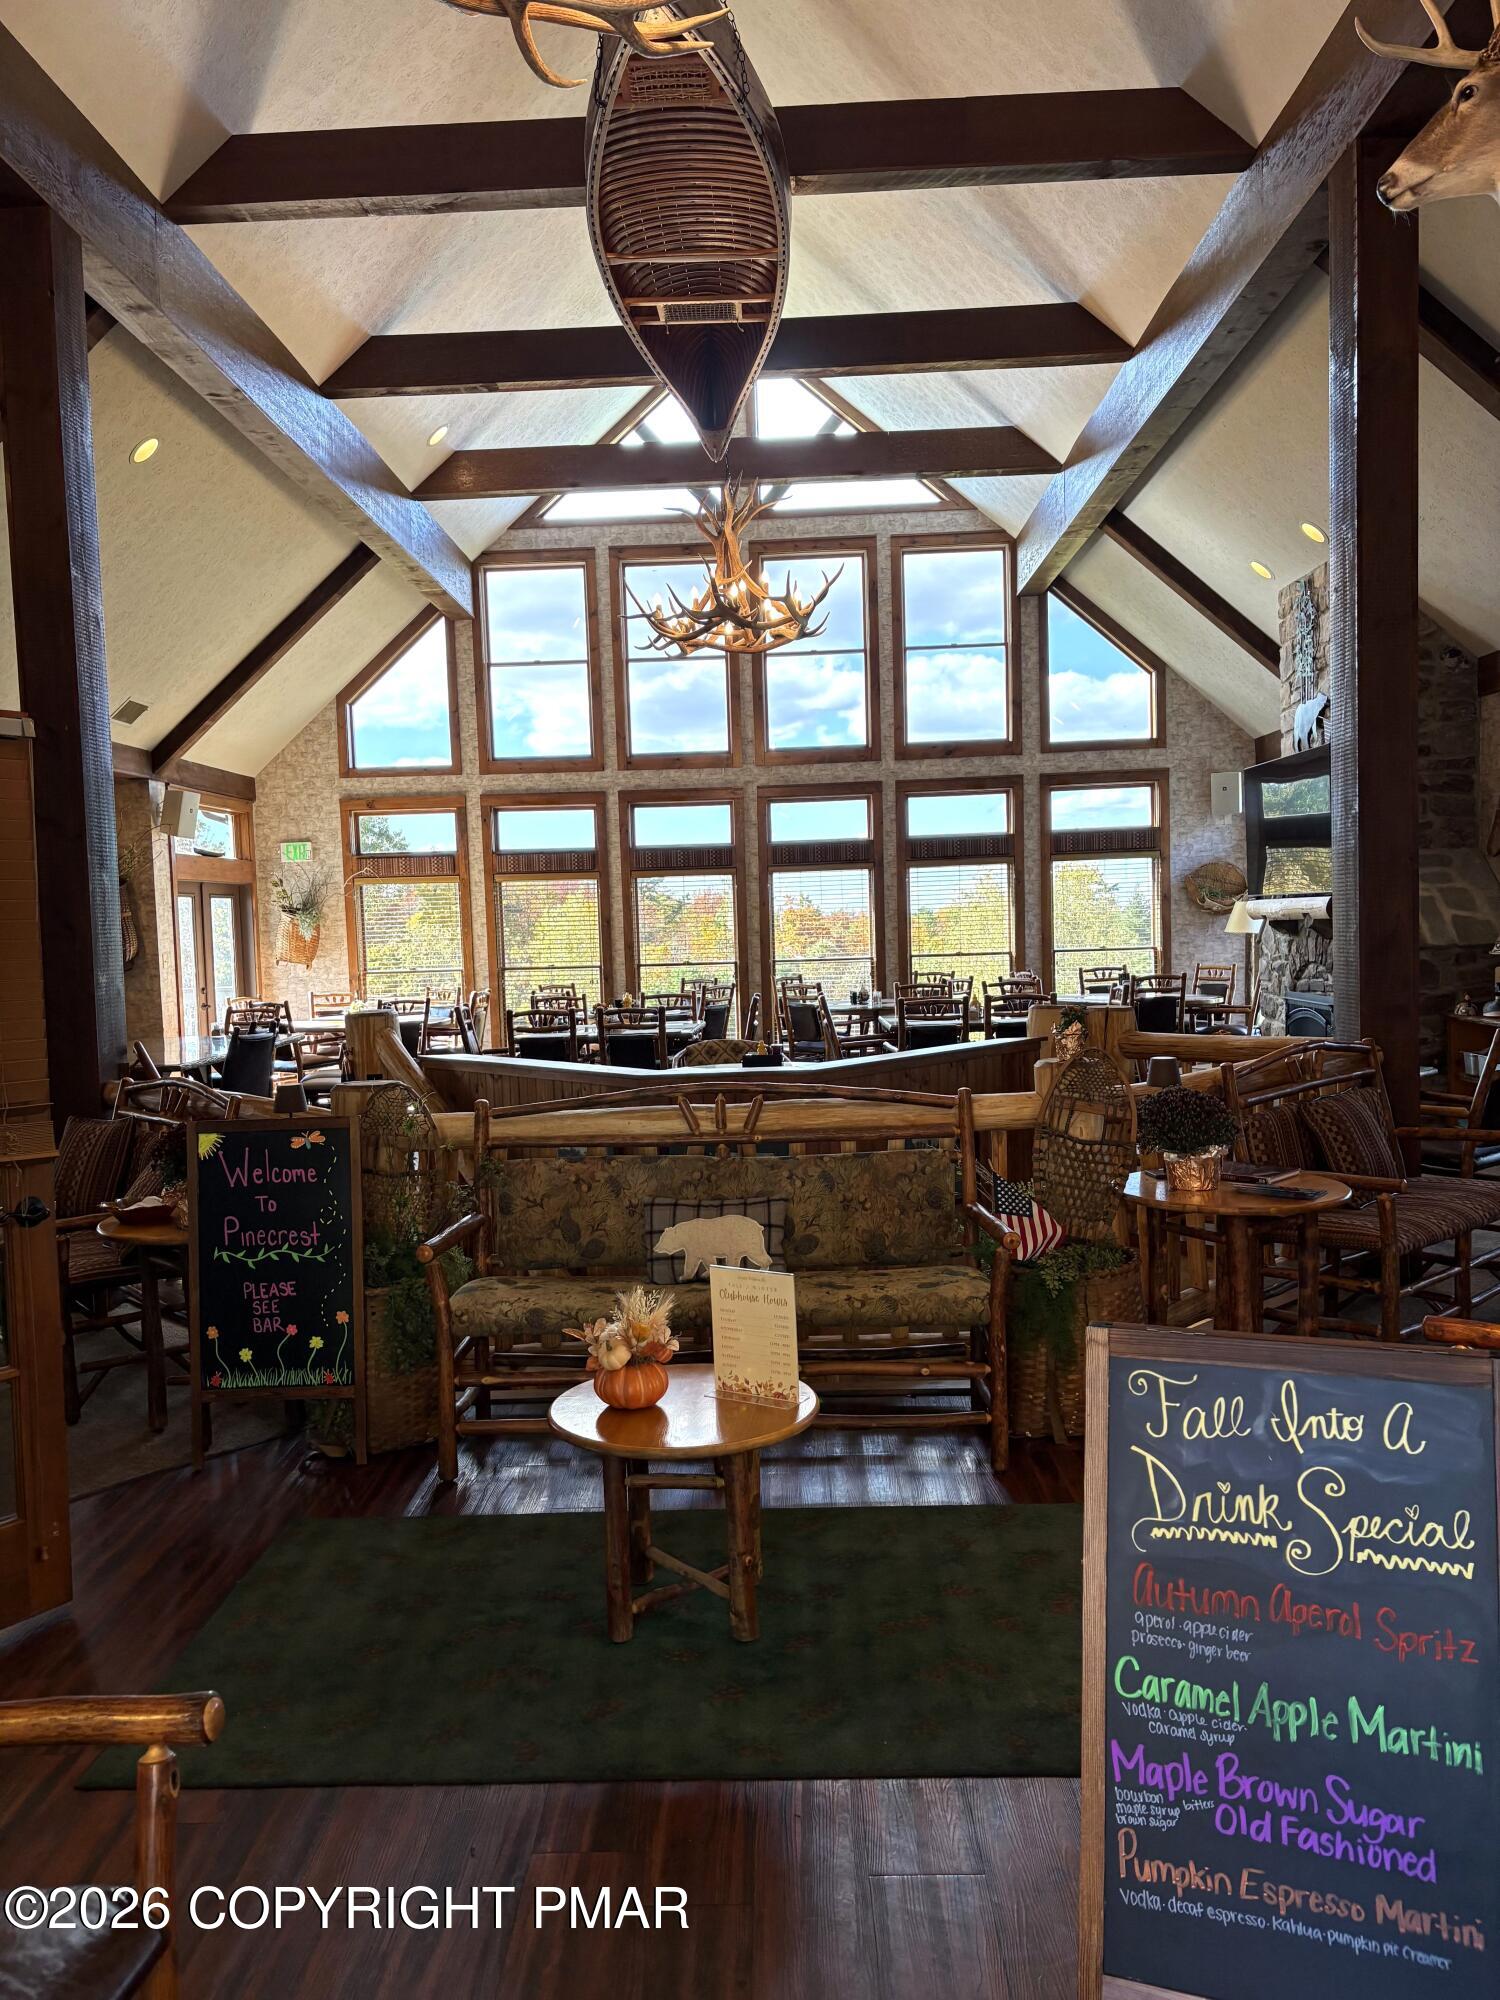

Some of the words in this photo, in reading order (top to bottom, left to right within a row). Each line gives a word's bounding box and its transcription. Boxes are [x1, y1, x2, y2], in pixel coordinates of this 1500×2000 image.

[218, 1147, 317, 1187] Welcome
[255, 1195, 277, 1212] To
[224, 1216, 320, 1246] Pinecrest
[243, 1281, 297, 1300] PLEASE
[252, 1299, 280, 1315] SEE
[253, 1316, 286, 1333] BAR
[1128, 1369, 1252, 1439] Fall
[1270, 1379, 1364, 1454] Into
[1130, 1444, 1293, 1553] Drink
[1286, 1466, 1475, 1575] Special
[1132, 1561, 1261, 1622] Autumn
[1374, 1606, 1480, 1664] Spritz
[1134, 1611, 1175, 1633] aperol
[1226, 1645, 1251, 1663] beer
[1114, 1655, 1240, 1722] Caramel
[1247, 1681, 1340, 1743] Apple
[1347, 1695, 1483, 1776] Martini
[1148, 1721, 1197, 1740] caramel
[1200, 1729, 1235, 1747] syrup
[1111, 1738, 1209, 1801] Maple
[1215, 1751, 1319, 1815] Brown
[1325, 1774, 1426, 1844] Sugar
[1115, 1786, 1164, 1804] bourbon
[1115, 1813, 1147, 1826] brown
[1149, 1816, 1179, 1831] sugar
[1116, 1802, 1149, 1816] maple
[1214, 1803, 1272, 1844] Old
[1280, 1814, 1437, 1885] Fashioned
[1117, 1827, 1233, 1897] Pumpkin
[1240, 1868, 1365, 1922] Espresso
[1375, 1894, 1485, 1952] Martini
